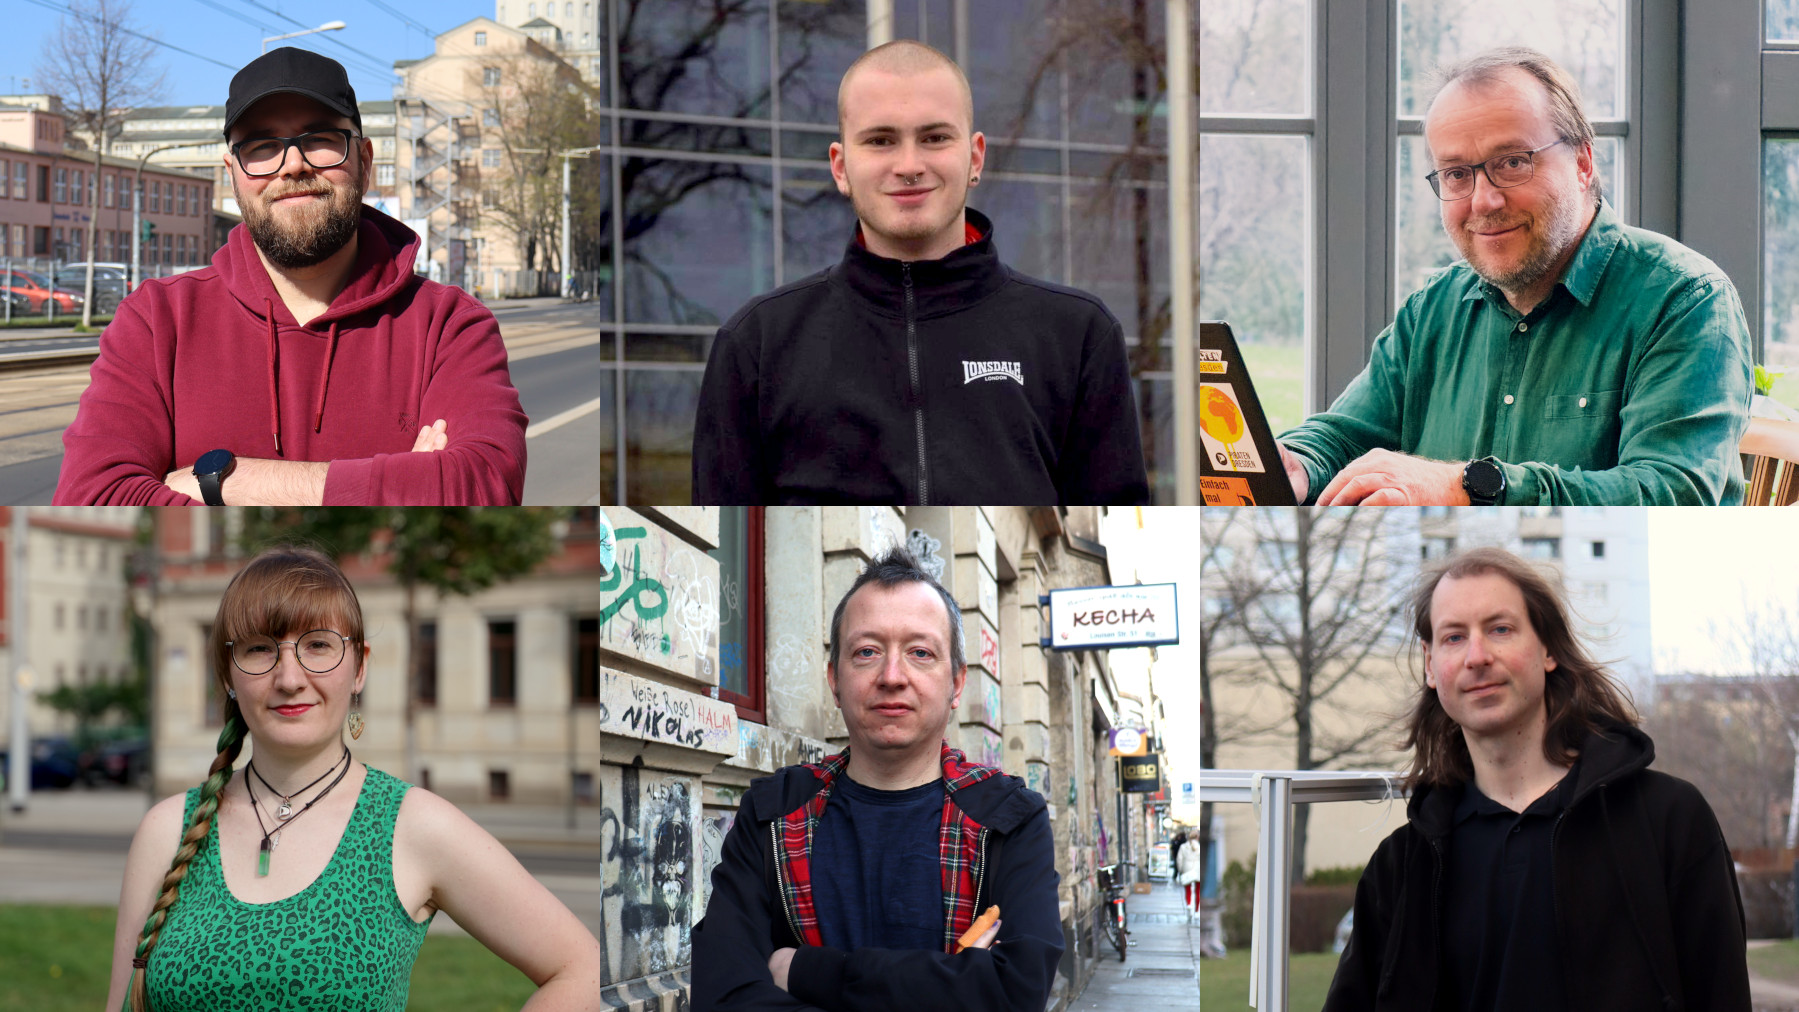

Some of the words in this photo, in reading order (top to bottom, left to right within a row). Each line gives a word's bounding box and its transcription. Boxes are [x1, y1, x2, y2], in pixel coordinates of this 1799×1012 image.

[962, 361, 1024, 385] LONSDALE
[1228, 451, 1251, 460] PIRATEN
[1232, 460, 1256, 468] DRESDEN
[1200, 479, 1230, 490] Einfach
[1205, 494, 1221, 503] mal
[1073, 608, 1155, 627] KECHA
[698, 705, 732, 732] HALM
